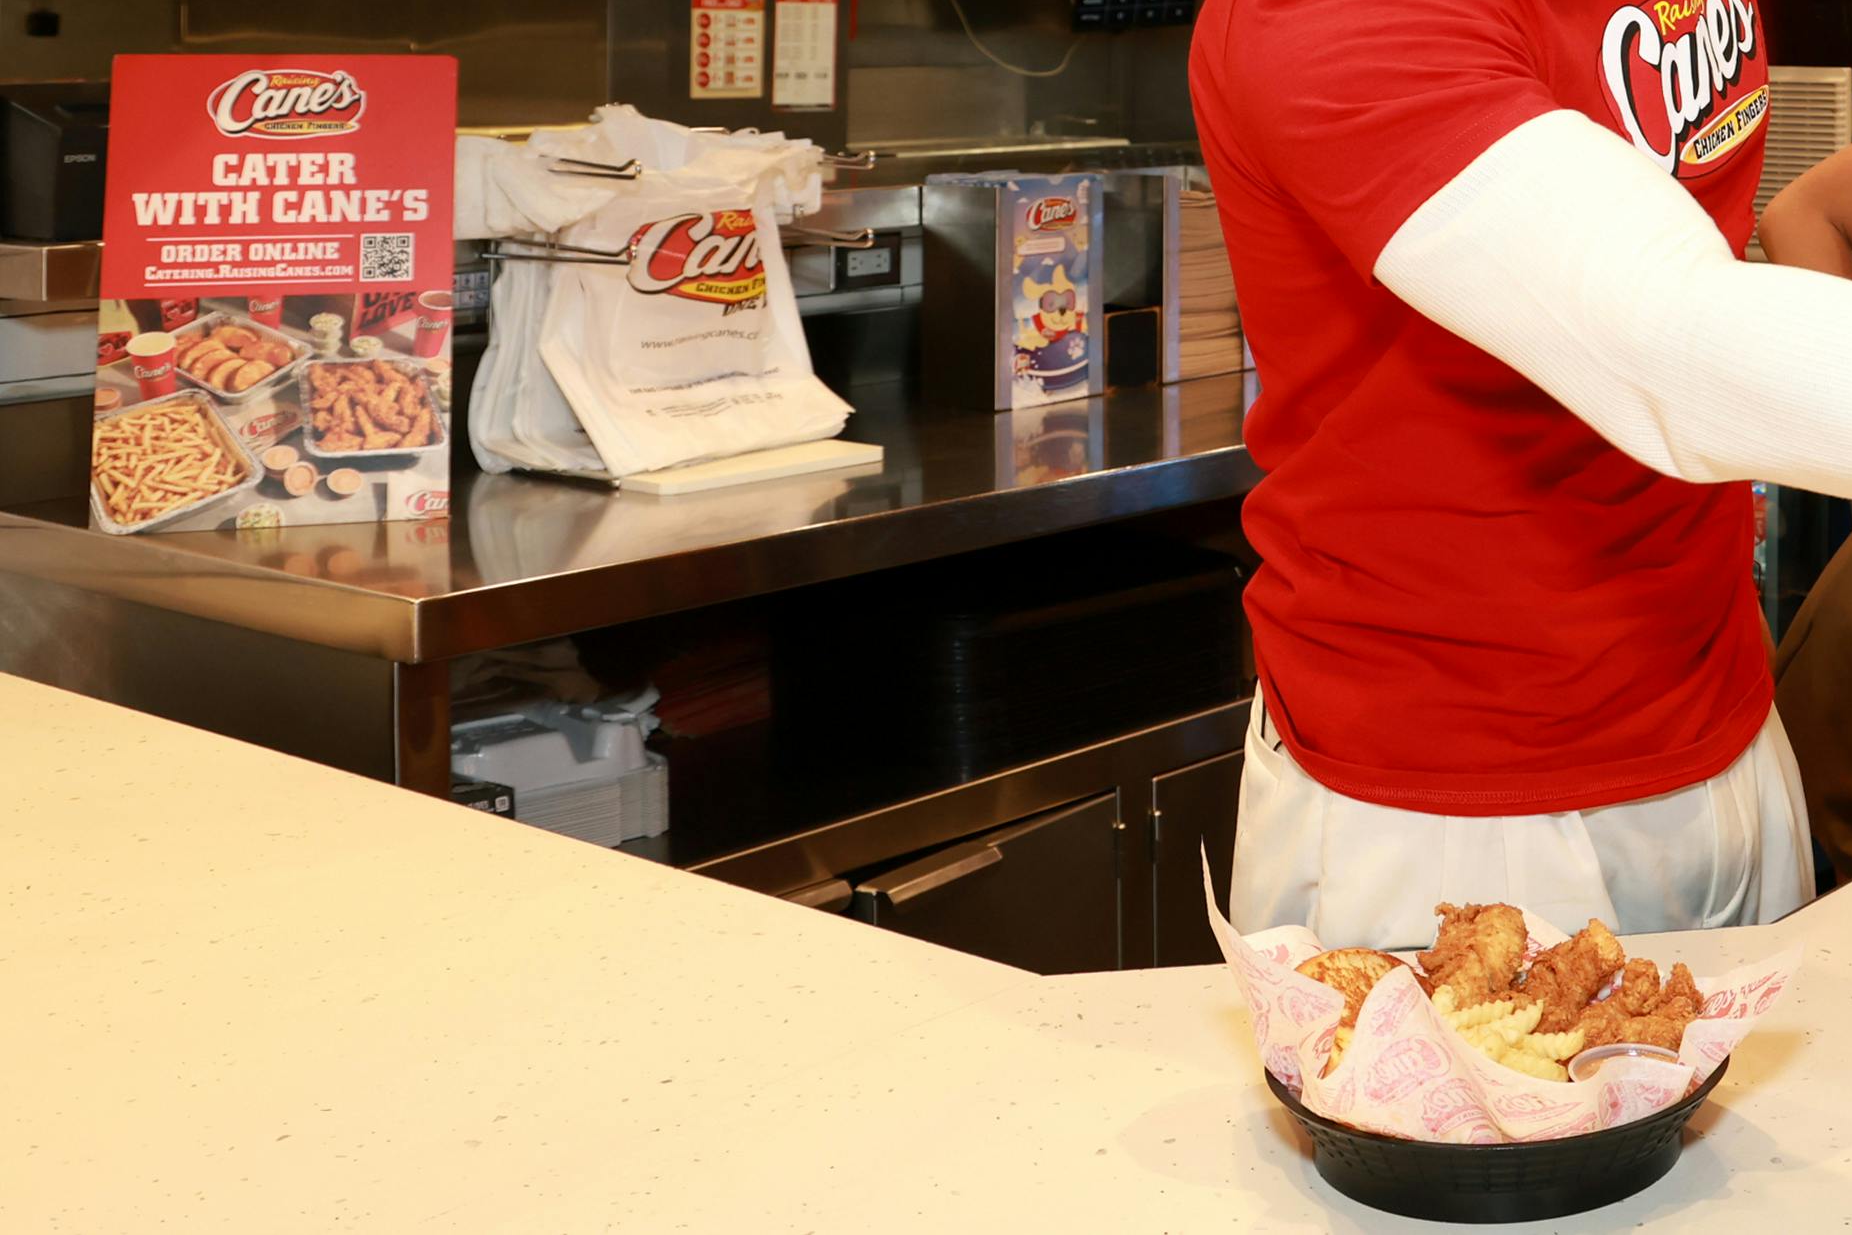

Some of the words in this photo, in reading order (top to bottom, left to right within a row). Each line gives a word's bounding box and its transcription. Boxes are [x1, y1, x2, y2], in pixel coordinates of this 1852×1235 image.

[271, 75, 320, 87] Raising
[216, 71, 360, 132] Cane's
[1693, 123, 1736, 160] CHICKEN
[212, 153, 357, 186] CATER
[132, 192, 261, 226] WITH
[272, 189, 429, 223] CANE'S
[161, 243, 242, 263] ORDER
[248, 242, 340, 261] ONLINE
